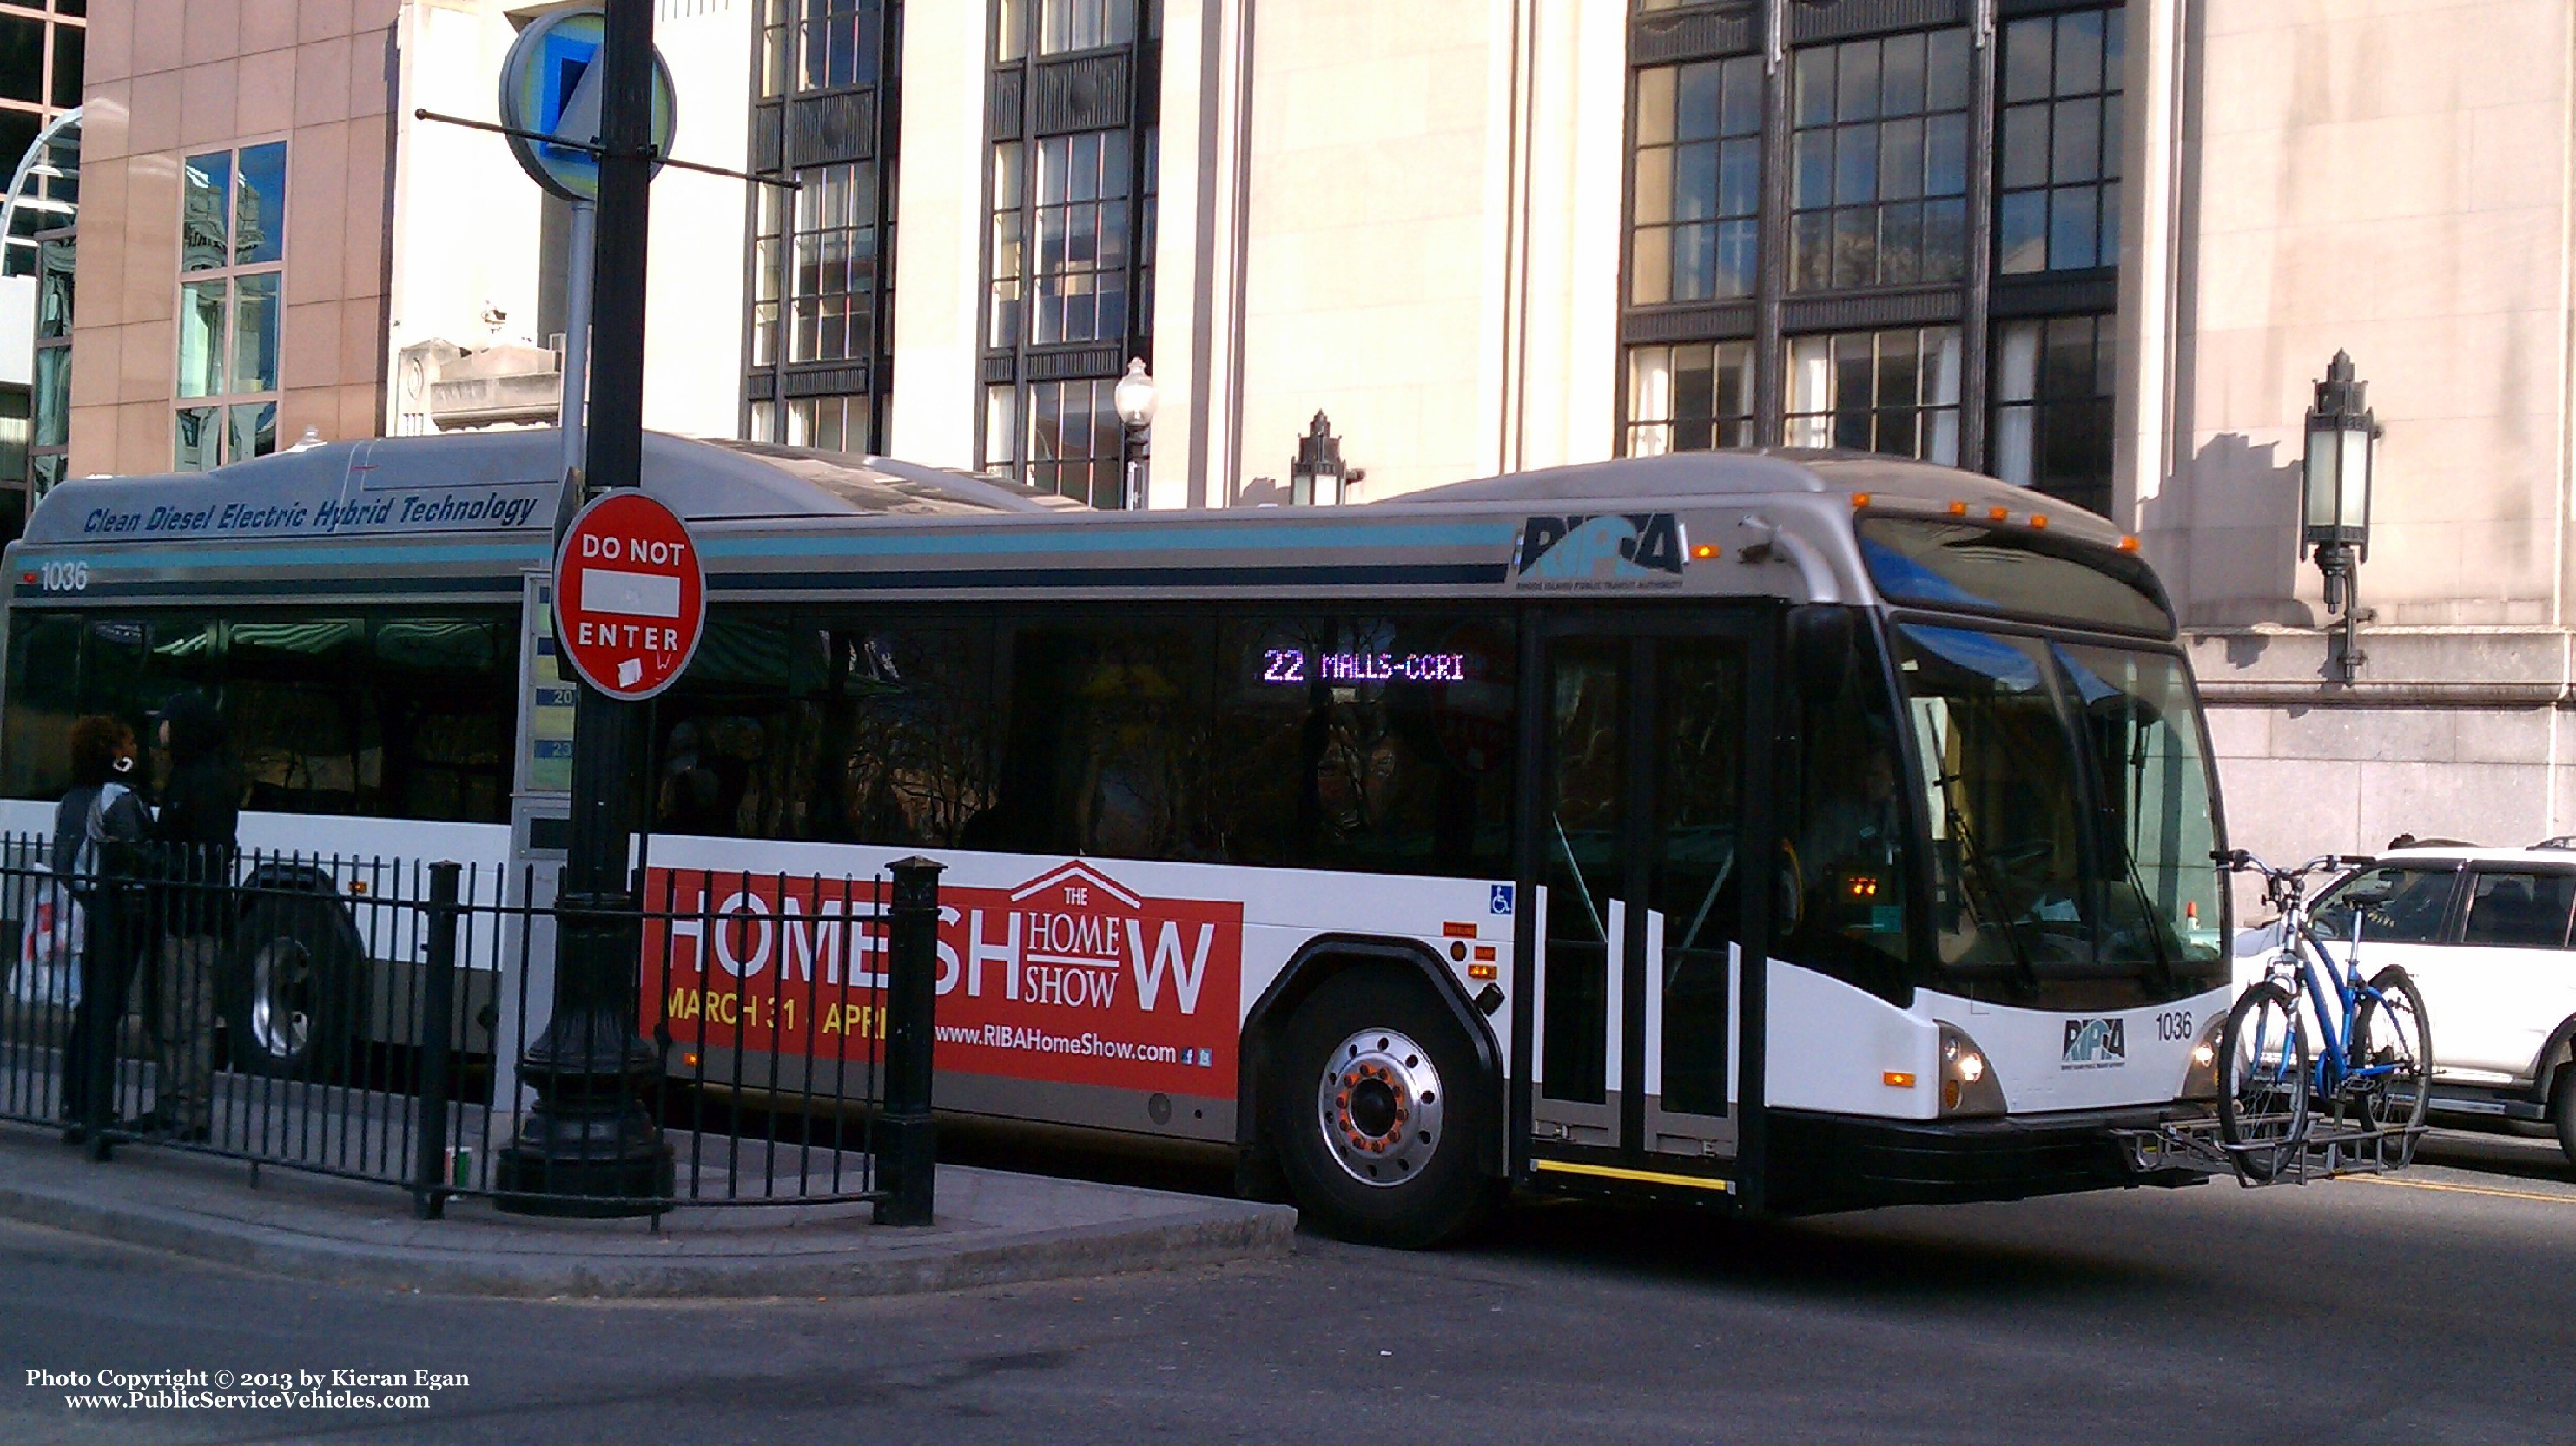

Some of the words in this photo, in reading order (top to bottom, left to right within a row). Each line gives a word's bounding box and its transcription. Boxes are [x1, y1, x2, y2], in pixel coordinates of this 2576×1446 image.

[84, 508, 141, 533] Clean
[145, 504, 215, 531] Diesel
[217, 501, 308, 529] Electric
[314, 496, 395, 532] Hybrid
[398, 492, 538, 527] Technology
[583, 533, 620, 560] DO
[630, 538, 685, 566] NOT
[41, 561, 89, 591] 1036
[578, 622, 679, 652] ENTER
[1265, 650, 1304, 681] 22
[1322, 653, 1464, 681] MALLS-CCRI
[554, 690, 573, 704] 20
[1064, 887, 1087, 906] THE
[1027, 912, 1120, 955] HOME
[1025, 966, 1119, 1009] SHOW
[667, 987, 757, 1027] MARCH
[765, 997, 795, 1030] 31
[822, 1002, 887, 1040] APRI
[2156, 1011, 2193, 1042] 1036
[935, 1023, 1177, 1064] www.RIBAHomeShow.com
